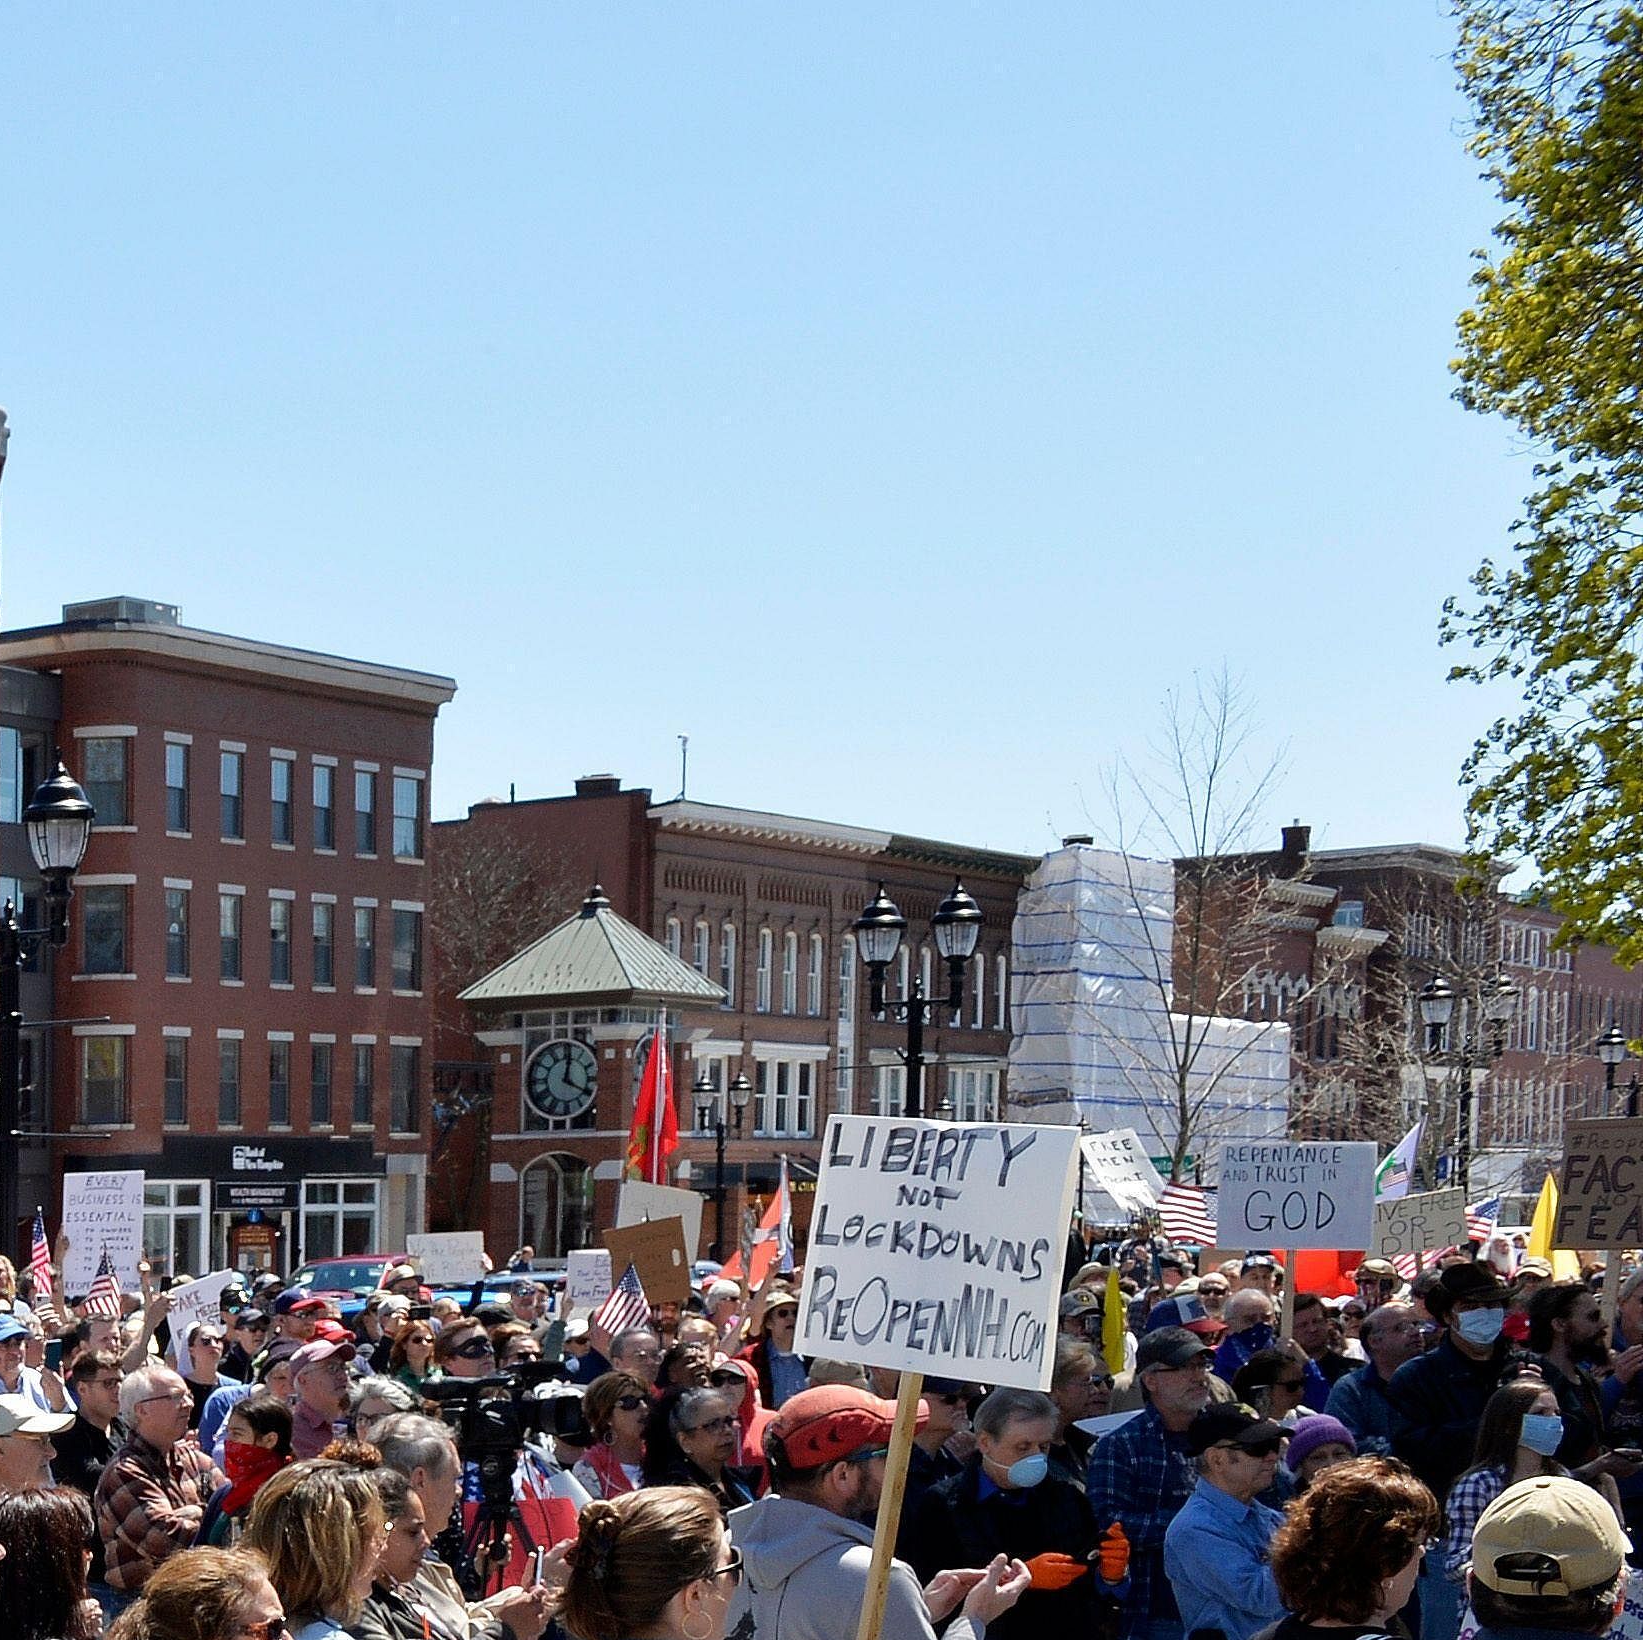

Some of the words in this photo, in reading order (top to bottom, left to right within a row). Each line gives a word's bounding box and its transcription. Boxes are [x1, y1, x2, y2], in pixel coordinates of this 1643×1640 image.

[1090, 1138, 1133, 1151] FREE
[829, 1123, 1038, 1187] LIBERTY
[1098, 1156, 1134, 1167] MEN
[1226, 1146, 1343, 1164] REPENTANCE
[85, 1175, 128, 1187] EVERY
[1222, 1168, 1253, 1183] AND
[1255, 1165, 1310, 1184] TRUST
[1322, 1168, 1337, 1180] IN
[1564, 1155, 1643, 1194] FAC
[69, 1194, 126, 1206] BUSINESS
[131, 1194, 142, 1205] IS
[896, 1185, 963, 1211] NOT
[1419, 1190, 1461, 1214] FREE
[66, 1211, 136, 1223] ESSENTIAL
[1244, 1190, 1336, 1232] GOD
[1389, 1215, 1434, 1236] OR
[815, 1204, 1050, 1282] LOCKDOWNS
